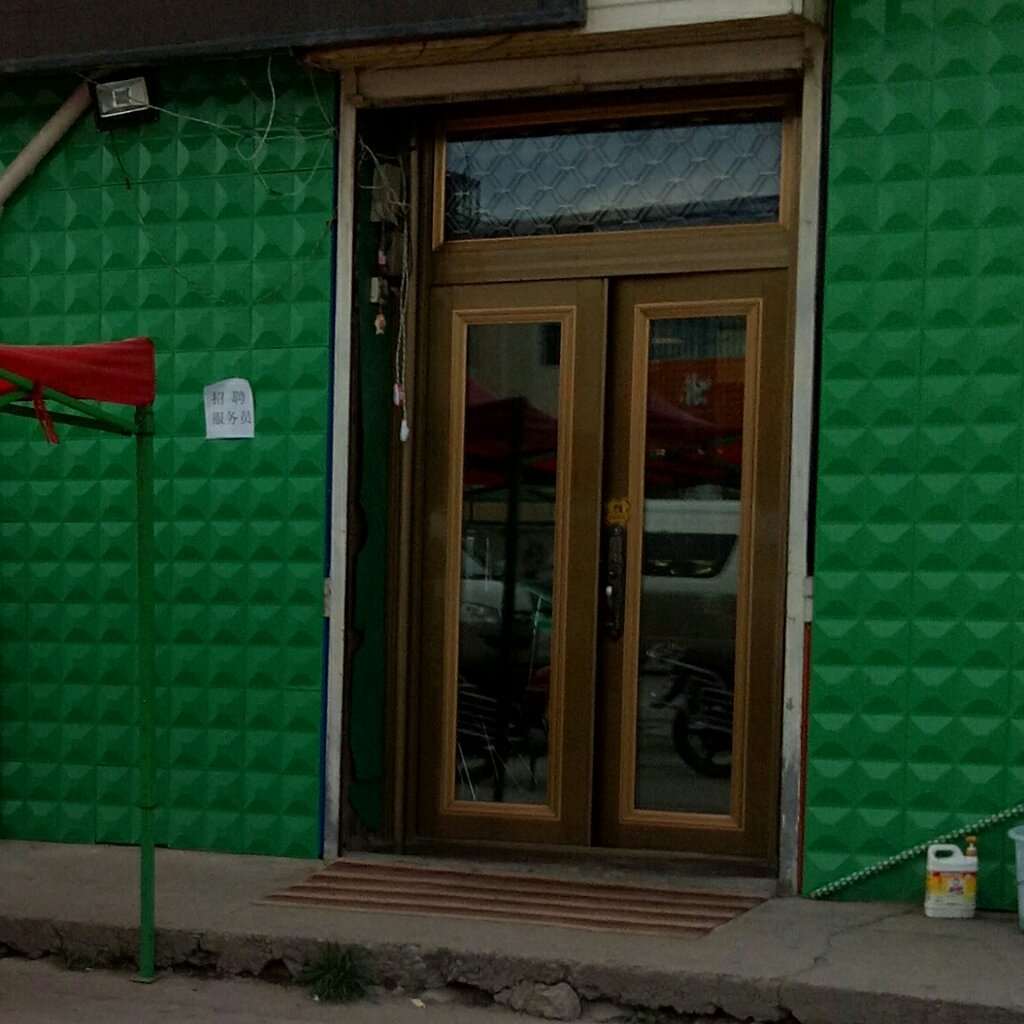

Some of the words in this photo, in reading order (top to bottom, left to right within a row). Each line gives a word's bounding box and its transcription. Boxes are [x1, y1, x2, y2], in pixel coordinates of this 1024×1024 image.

[210, 390, 246, 406] 招聘
[212, 410, 252, 425] 服务员
